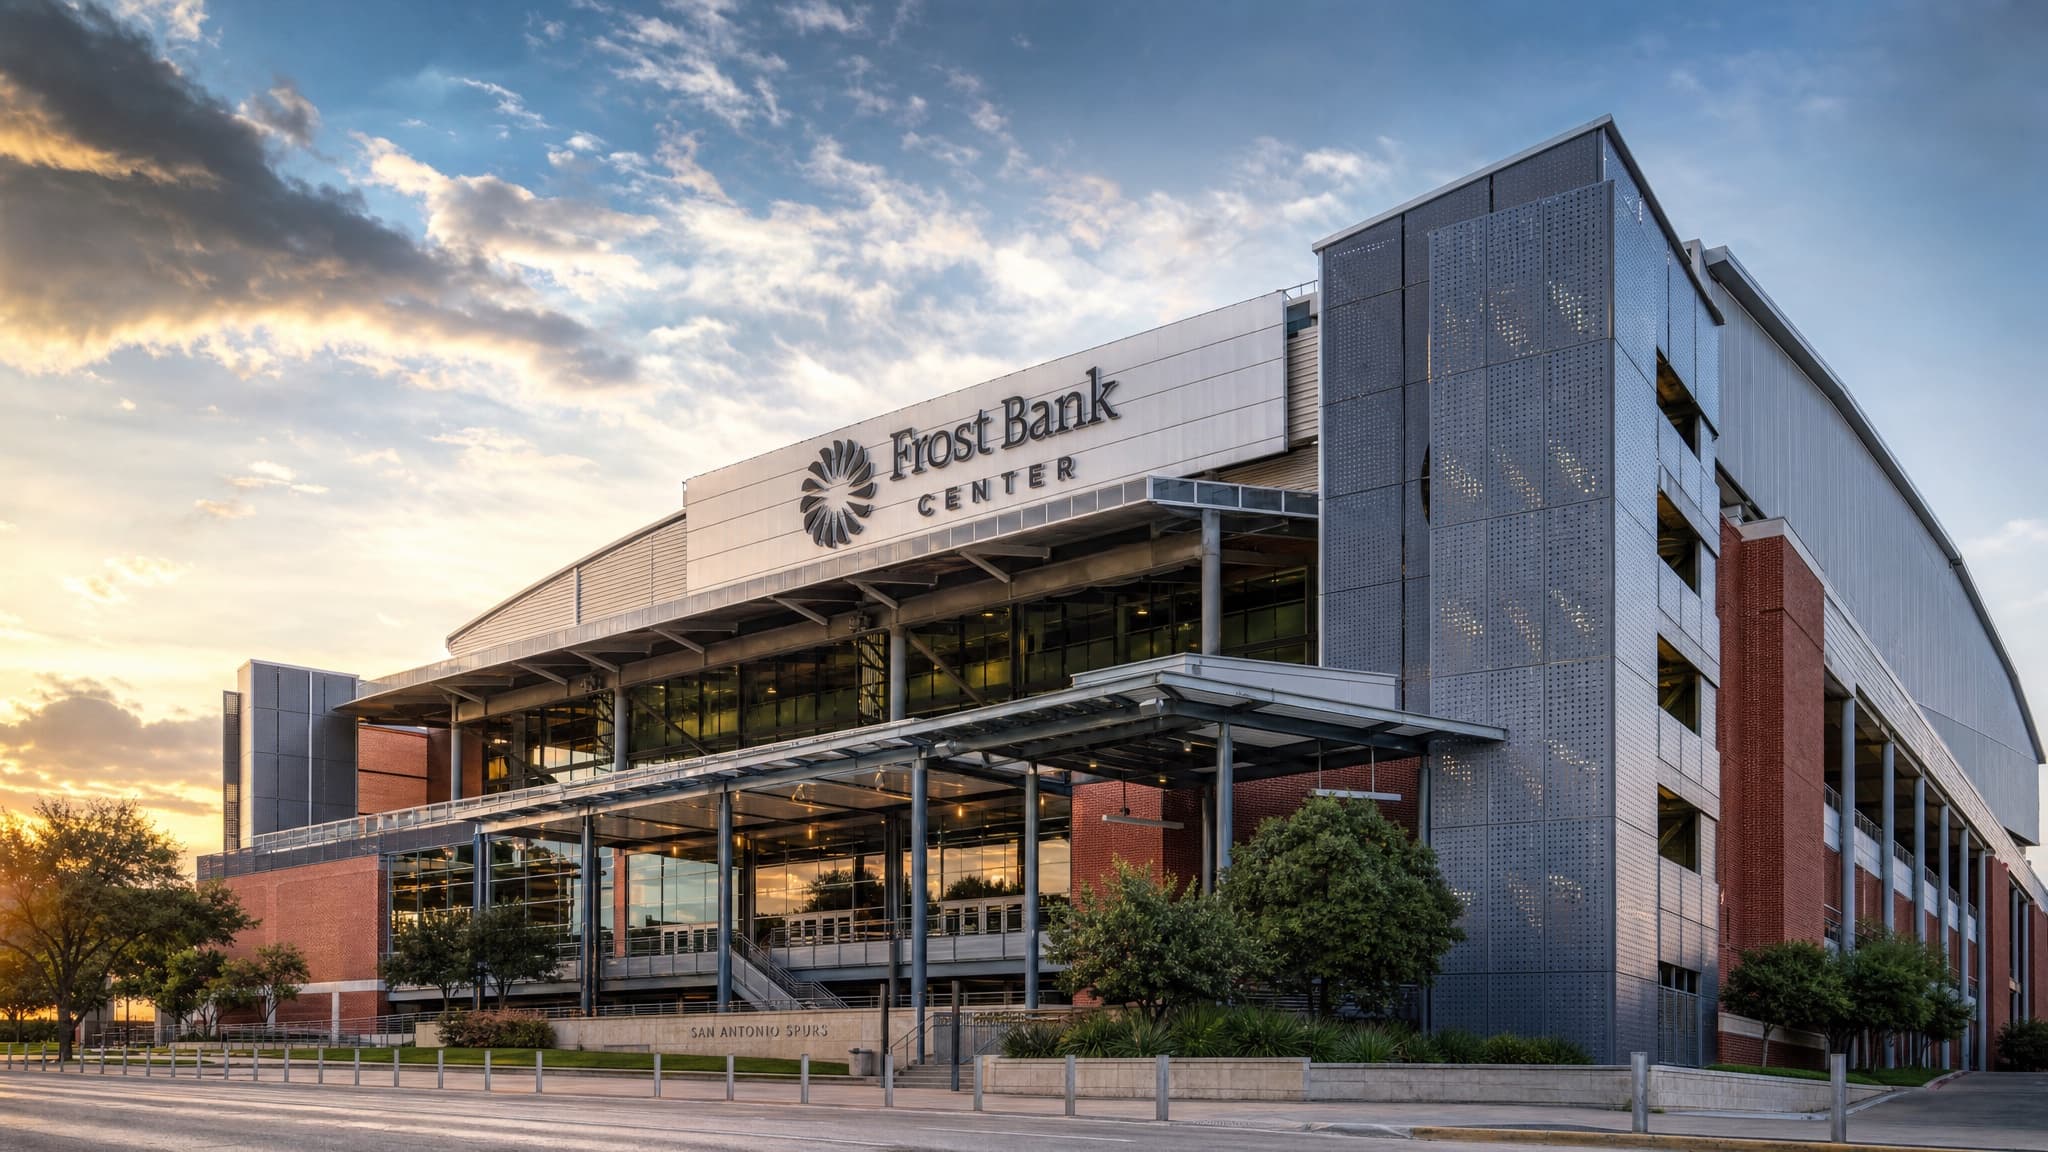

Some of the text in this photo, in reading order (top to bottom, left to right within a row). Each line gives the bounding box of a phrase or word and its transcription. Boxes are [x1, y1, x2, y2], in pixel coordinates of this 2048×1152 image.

[890, 366, 1120, 481] Frost Bank
[917, 456, 1076, 517] CENTER
[691, 1024, 828, 1038] SAN ANTONIO SPURS
